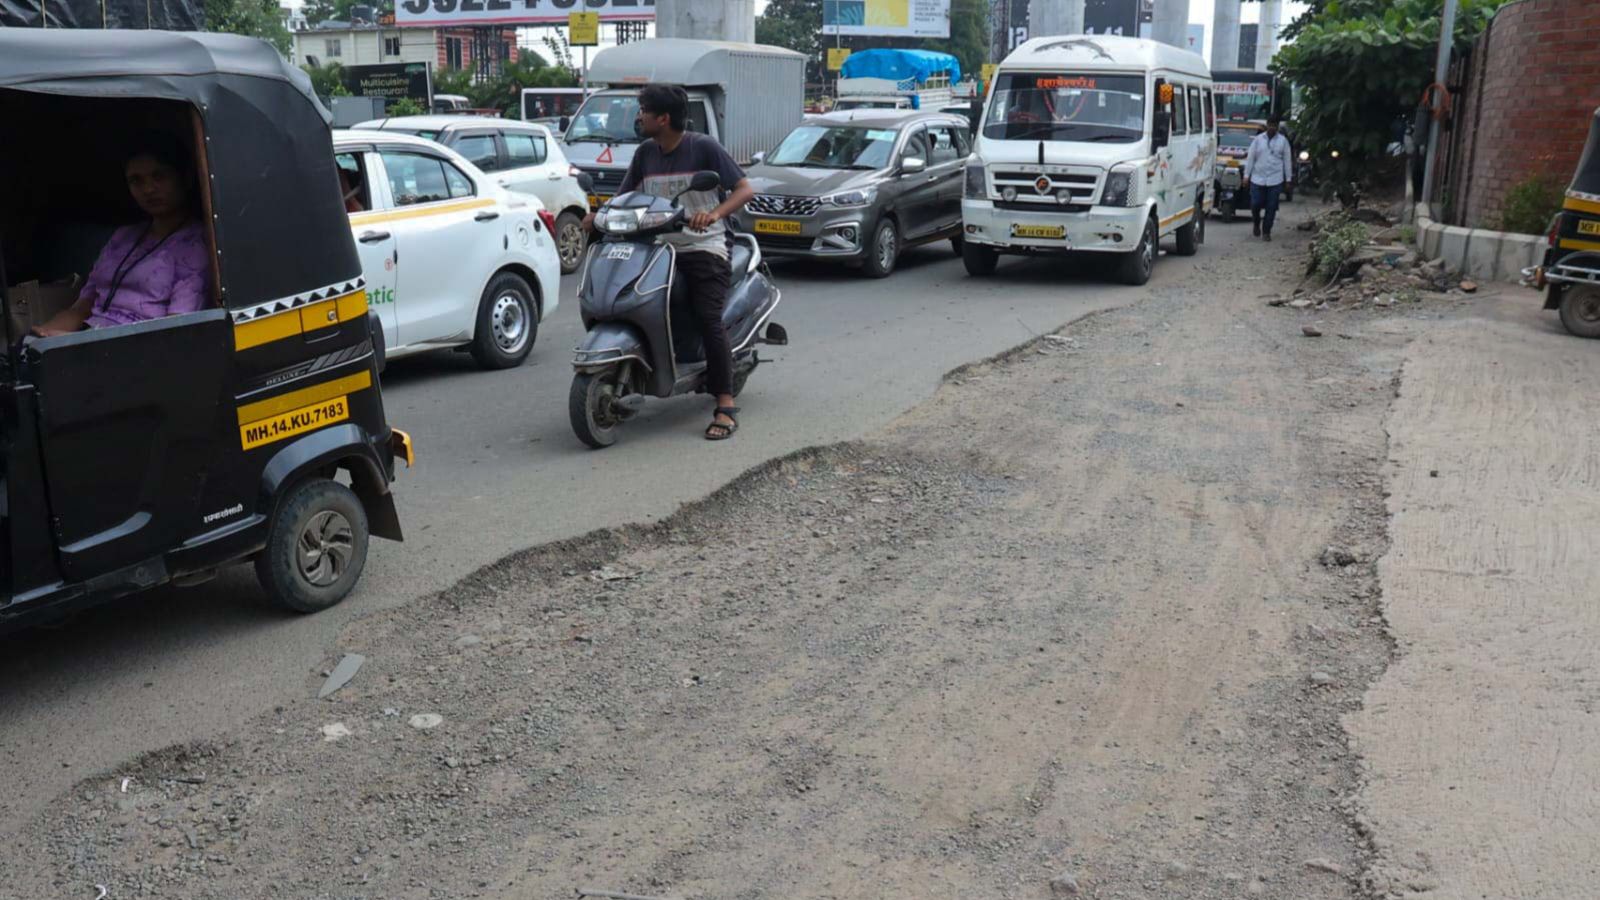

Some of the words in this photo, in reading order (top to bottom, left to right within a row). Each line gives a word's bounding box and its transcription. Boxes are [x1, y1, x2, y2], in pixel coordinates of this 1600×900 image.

[360, 78, 409, 87] Multicuisine
[363, 87, 409, 96] Restaurant
[246, 402, 344, 443] MH.14.KU.7183
